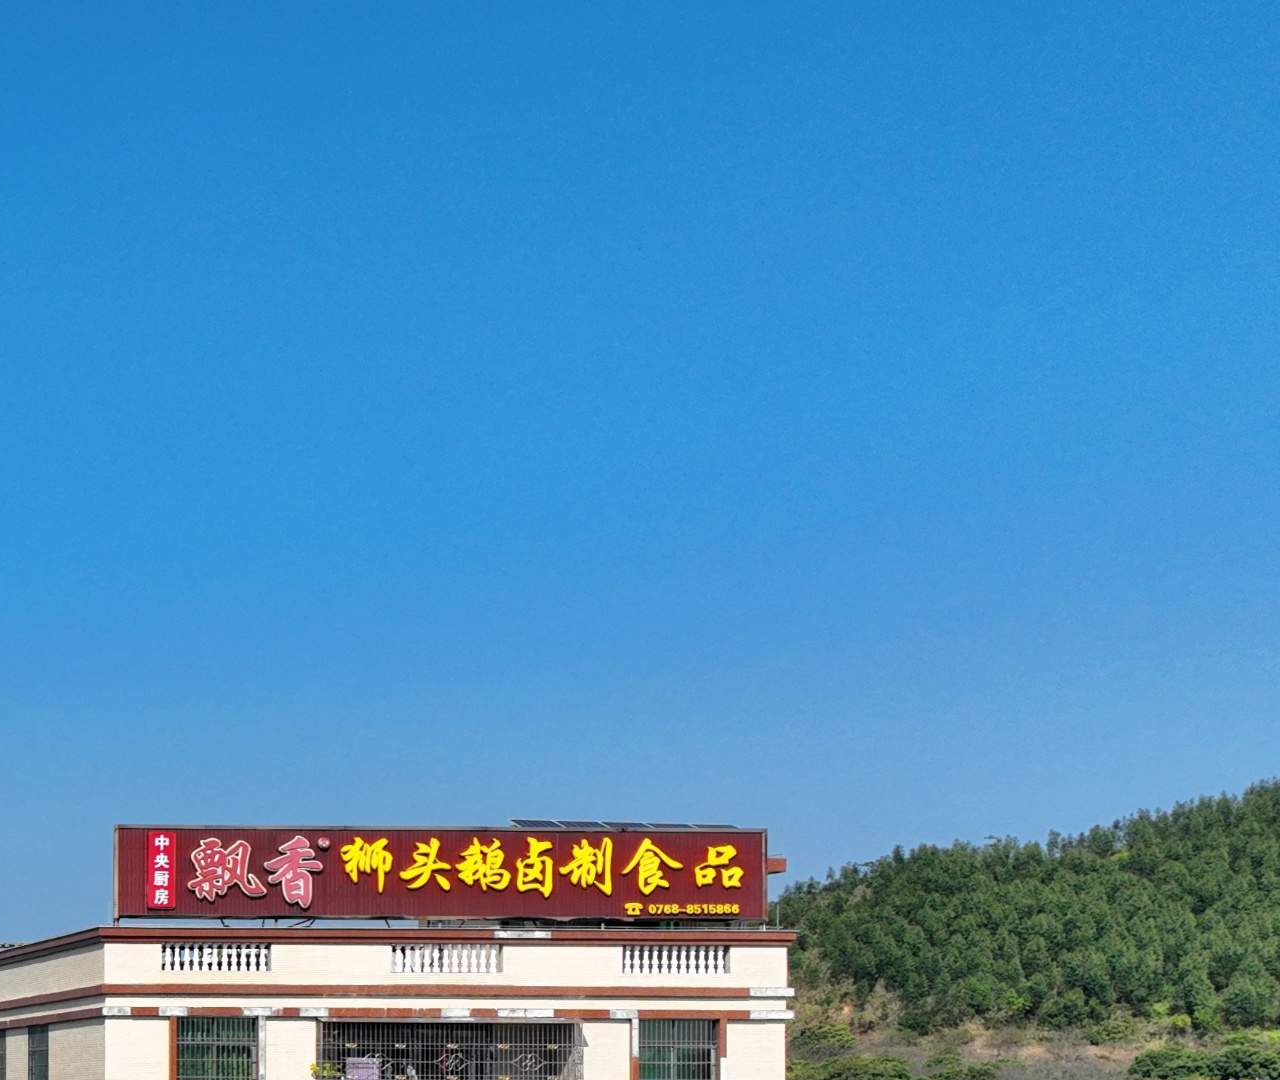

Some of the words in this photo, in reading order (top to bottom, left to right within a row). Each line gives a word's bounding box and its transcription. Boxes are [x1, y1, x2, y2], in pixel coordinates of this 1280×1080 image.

[154, 835, 170, 905] 中央厨房
[187, 833, 323, 909] 飘香
[340, 836, 744, 898] 狮头鹅卤制食品
